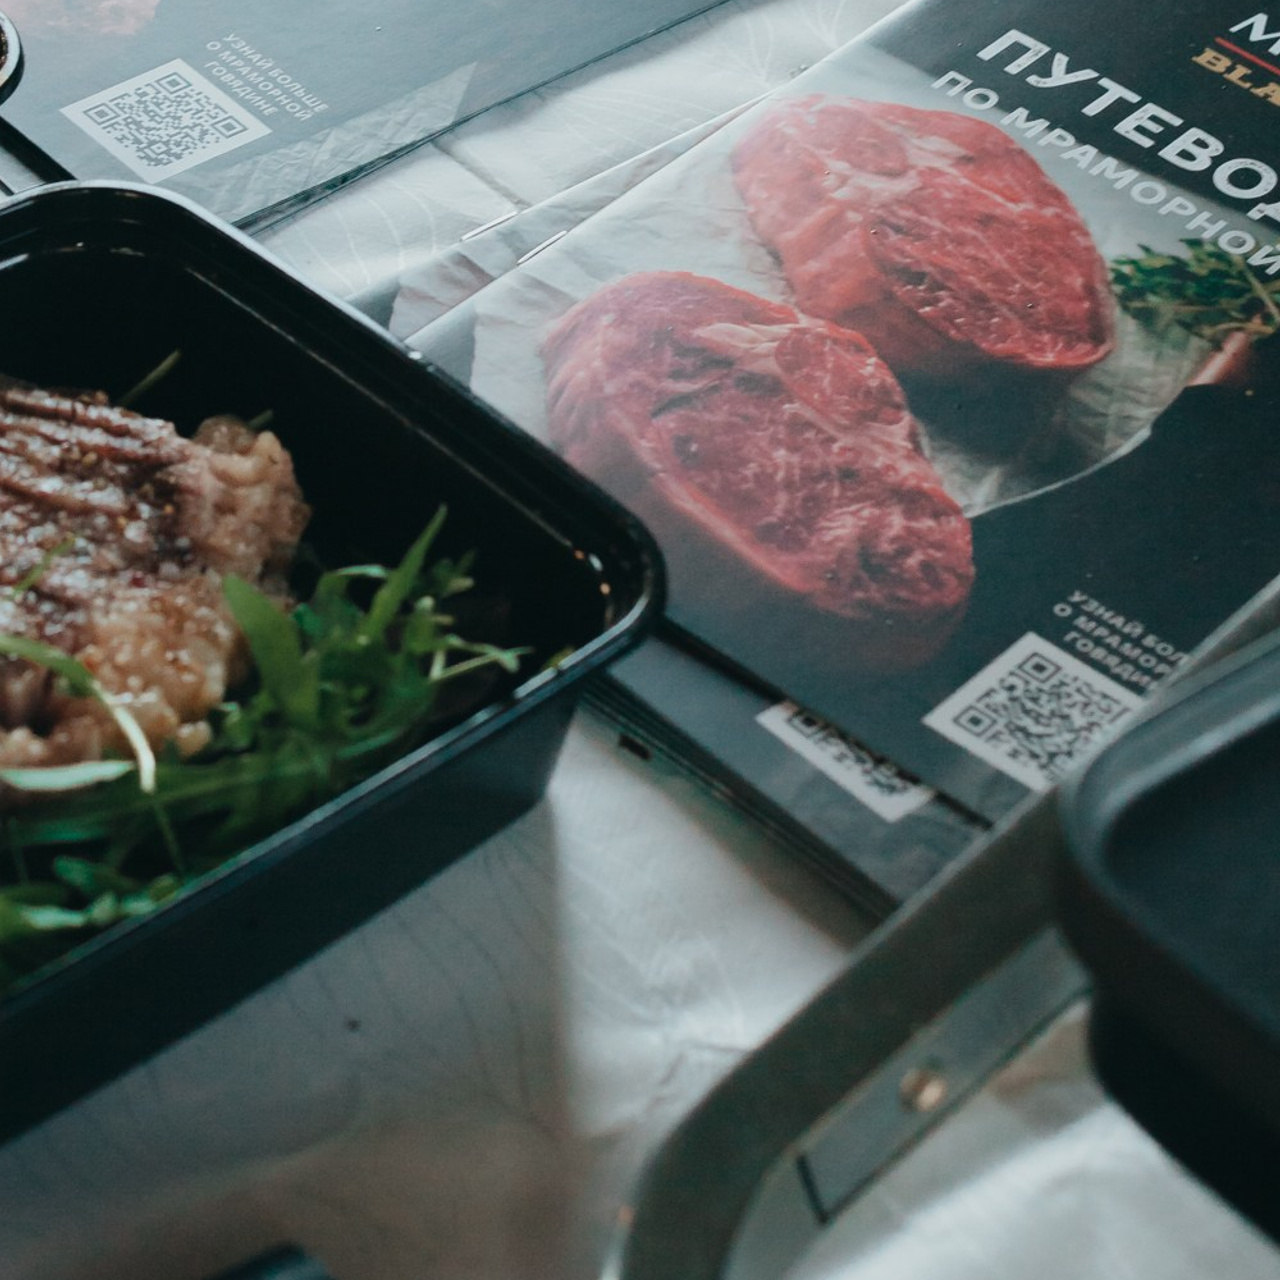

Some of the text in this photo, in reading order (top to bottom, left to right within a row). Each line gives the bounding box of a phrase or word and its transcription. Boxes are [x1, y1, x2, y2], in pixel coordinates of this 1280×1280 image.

[204, 61, 279, 116] ГОВЯДИНЕ
[206, 41, 315, 121] О МРАМОРНОЙ
[222, 33, 329, 113] УЗНАЙ БОЛЬШЕ
[930, 70, 999, 111] ПО
[1053, 603, 1073, 617] О
[1067, 590, 1145, 638] УЗНАЙ
